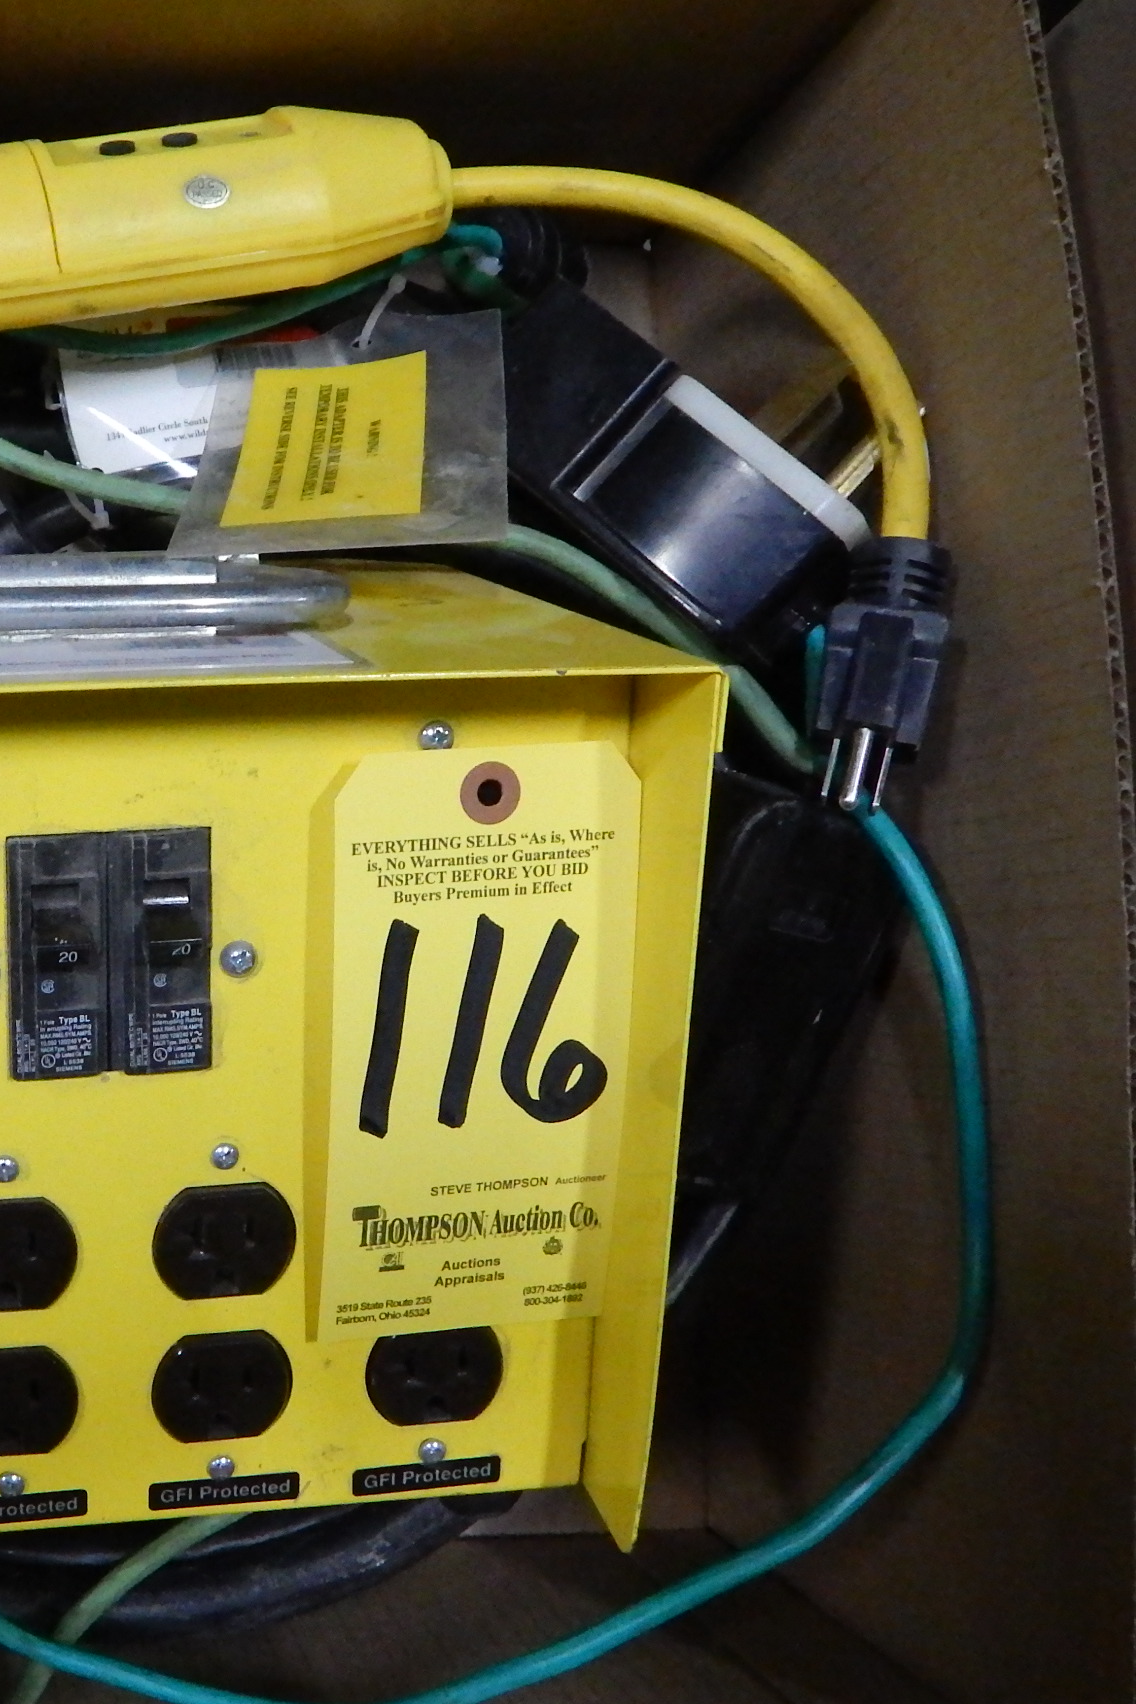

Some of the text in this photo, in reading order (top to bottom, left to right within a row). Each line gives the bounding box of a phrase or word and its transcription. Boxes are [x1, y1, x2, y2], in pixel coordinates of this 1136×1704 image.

[352, 836, 461, 856] EVERYTHING
[466, 833, 517, 848] SELLS
[551, 831, 566, 845] is,
[570, 828, 615, 841] Where
[367, 859, 382, 873] is,
[386, 857, 406, 871] No
[410, 852, 489, 869] Warranties
[492, 853, 508, 864] or
[377, 862, 589, 888] INSPECT BEFORE YOU BID
[394, 881, 573, 906] Buyers Premium in Effect
[58, 951, 78, 963] 20
[59, 1016, 78, 1025] Type
[79, 1014, 91, 1022] BL
[171, 1010, 190, 1019] Type
[191, 1008, 202, 1016] BL
[359, 913, 608, 1139] 116
[430, 1174, 607, 1197] STEVE THOMPSON Auctioneer
[352, 1201, 600, 1249] THOMPSON Auction Co.
[441, 1257, 501, 1271] Auctions
[434, 1271, 505, 1288] Appraisals
[523, 1285, 545, 1296] (937)
[336, 1296, 432, 1313] 3519 State Route 235
[379, 1311, 401, 1321] Ohio
[403, 1308, 430, 1318] 45324
[364, 1463, 491, 1489] GFI Protected
[160, 1479, 291, 1503] GFI Protected
